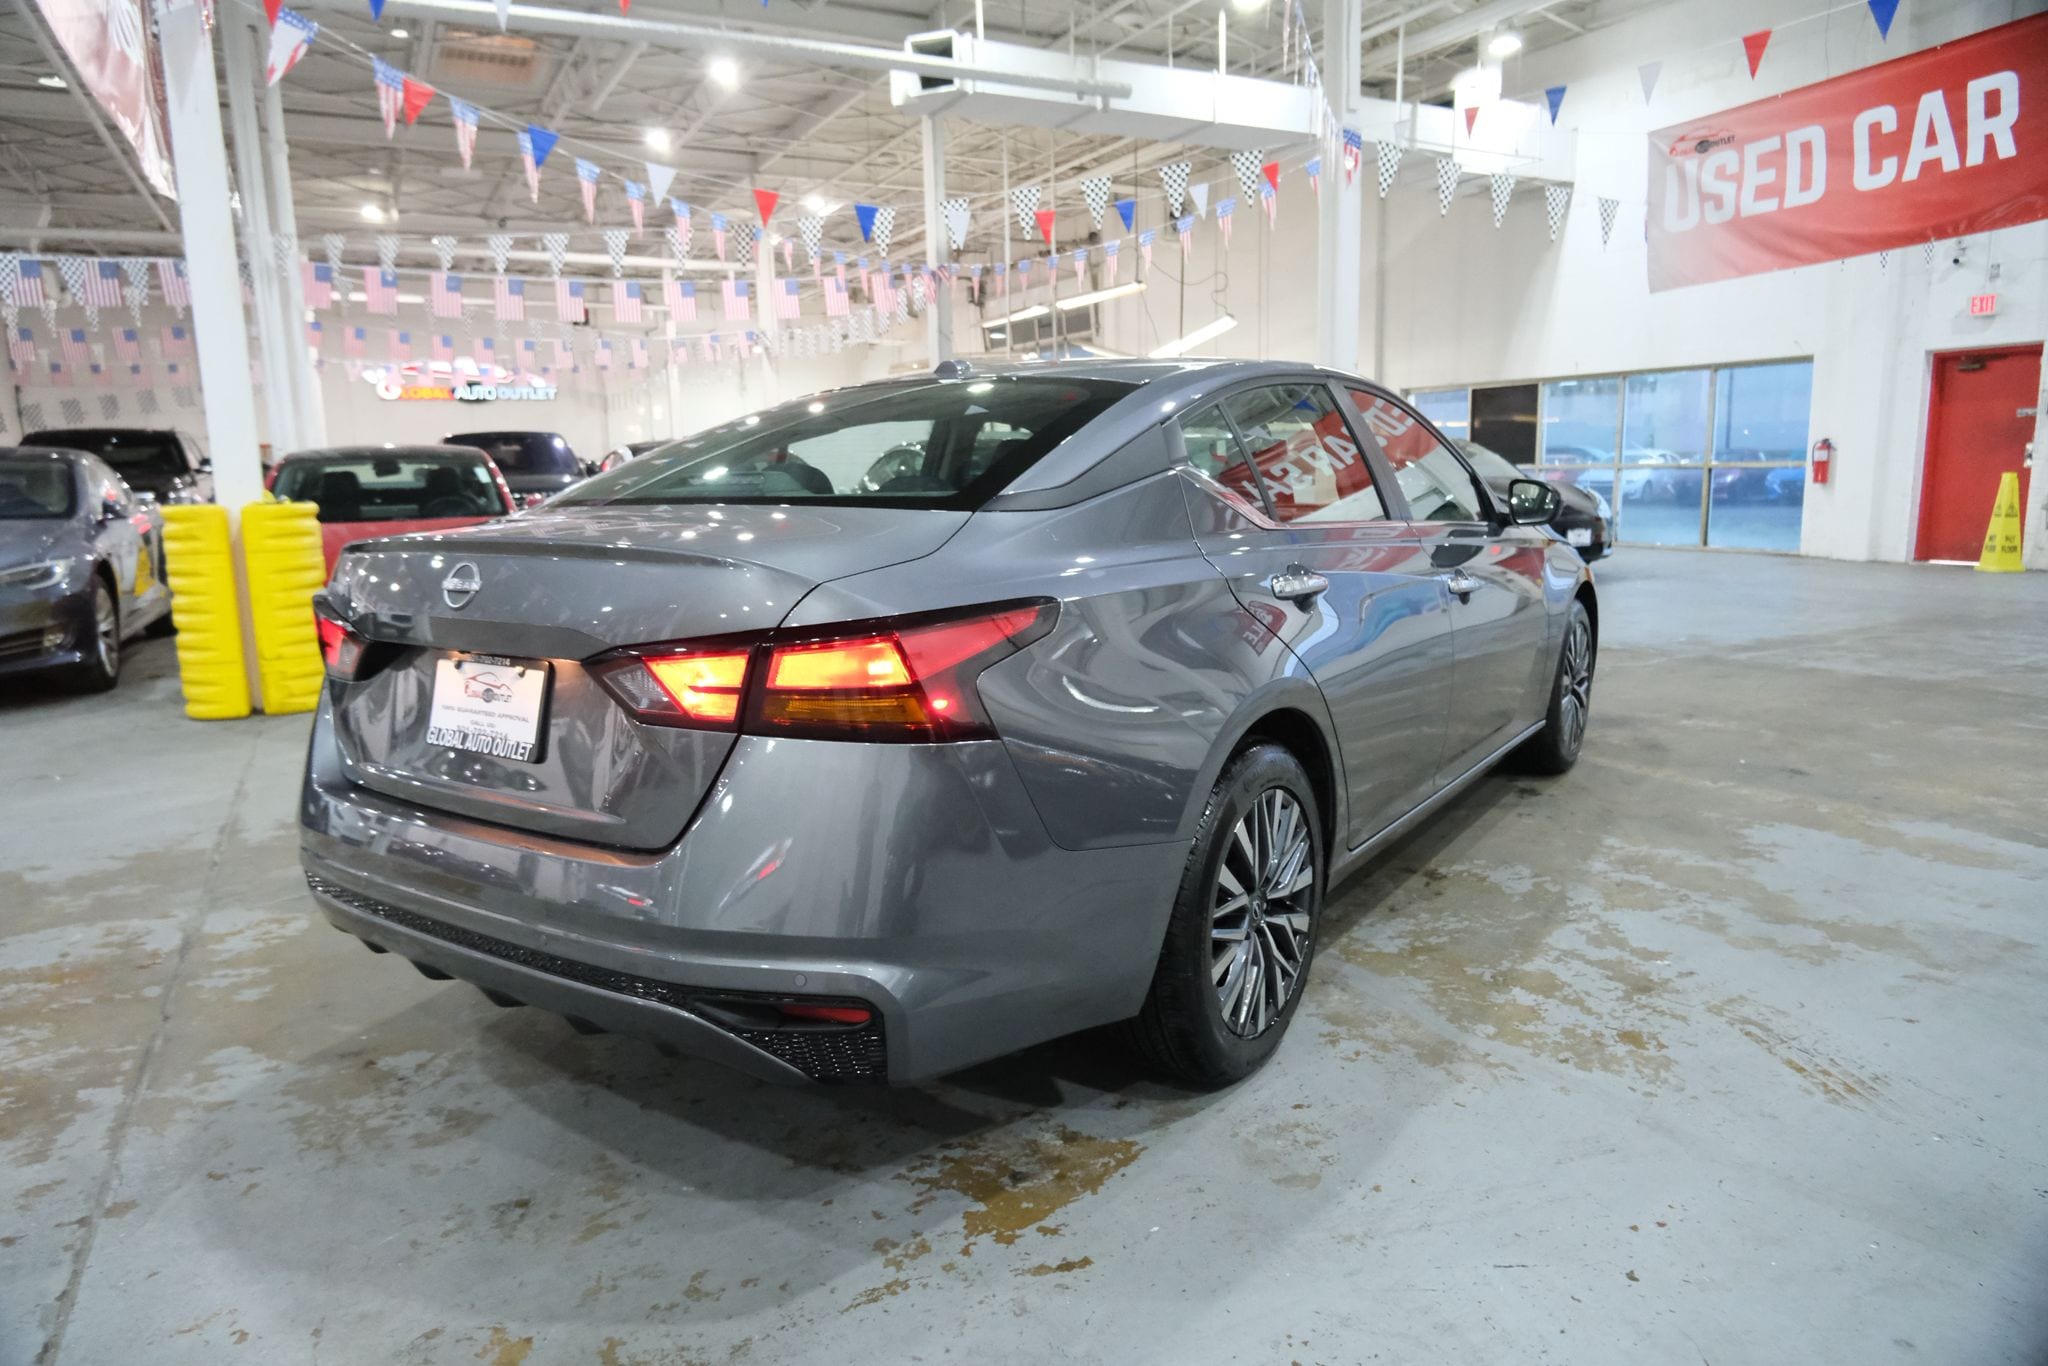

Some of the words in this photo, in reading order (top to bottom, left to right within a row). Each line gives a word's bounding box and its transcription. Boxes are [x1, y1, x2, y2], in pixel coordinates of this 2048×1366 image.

[1663, 124, 1826, 233] USED
[1852, 70, 2020, 192] CAR
[1971, 295, 1996, 314] EXIT
[453, 386, 497, 400] AUTO
[497, 386, 558, 400] OUTLET
[426, 726, 464, 750] GLOBAL
[465, 734, 493, 754] AUTO
[493, 737, 533, 761] OUTLET
